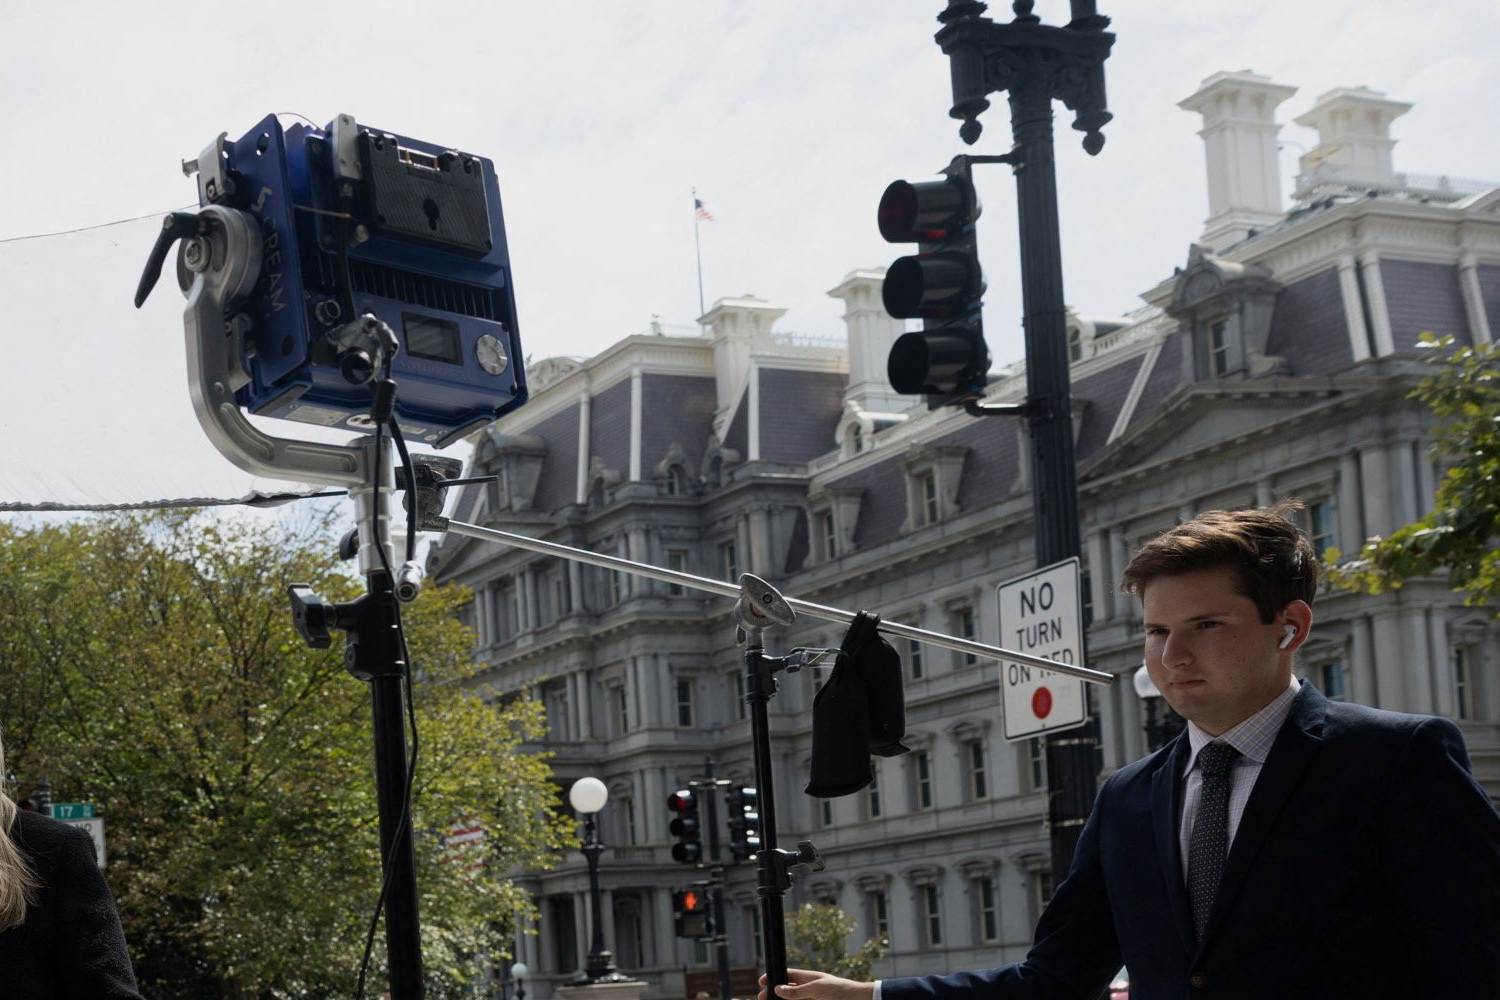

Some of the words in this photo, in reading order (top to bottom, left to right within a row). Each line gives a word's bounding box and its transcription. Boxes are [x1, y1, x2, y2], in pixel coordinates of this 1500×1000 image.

[263, 216, 285, 312] CREAM
[1020, 582, 1053, 618] NO
[1016, 617, 1062, 651] TURN
[1008, 664, 1031, 686] ON
[60, 806, 73, 818] 17
